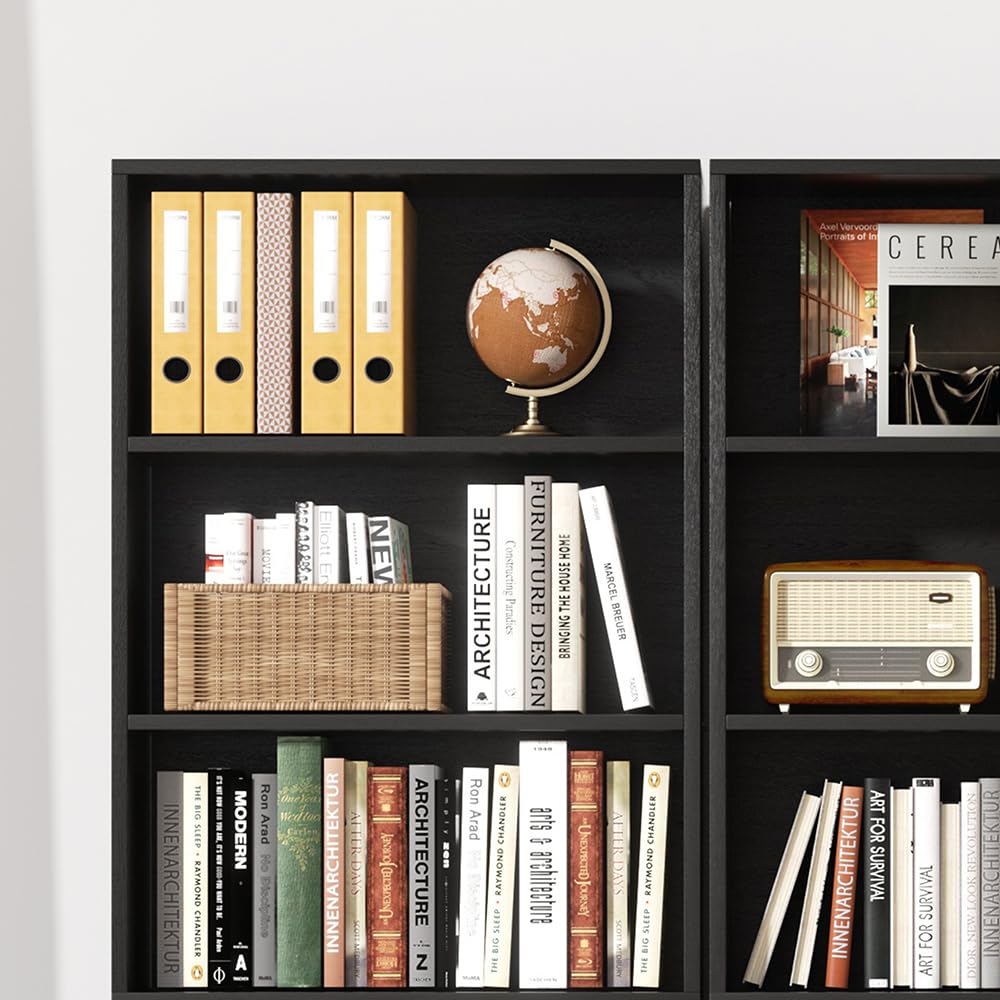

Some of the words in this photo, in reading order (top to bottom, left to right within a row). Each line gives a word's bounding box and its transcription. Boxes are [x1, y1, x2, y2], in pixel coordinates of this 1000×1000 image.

[531, 480, 546, 615] FURNITURE
[558, 534, 570, 559] HOME
[558, 562, 570, 592] HOUSE
[473, 507, 490, 680] ARCHITECTURE
[558, 595, 570, 612] THE
[603, 562, 618, 601] MARCEL
[611, 602, 627, 641] BREUER
[558, 615, 571, 659] BRINGING
[531, 623, 546, 708] DESIGN
[215, 775, 223, 786] IT'S
[215, 786, 223, 796] NOT
[469, 778, 483, 805] Ron
[215, 796, 223, 807] HOW
[869, 790, 885, 814] ART
[215, 821, 223, 832] YOU
[234, 790, 247, 870] MODERN
[468, 809, 482, 841] Arad
[529, 808, 556, 831] arts
[869, 818, 885, 844] FOR
[215, 854, 223, 865] HOW
[414, 777, 429, 926] ARCHITECTURE
[194, 860, 202, 907] RAYMOND
[215, 879, 223, 889] YOU
[529, 851, 559, 924] architecture
[869, 846, 885, 903] SURVIVAL
[163, 803, 180, 974] INNENARCHITEKTUR
[215, 890, 223, 904] WANT
[194, 910, 202, 958] CHANDLER
[215, 927, 223, 938] Paul
[215, 939, 223, 953] Arden
[234, 954, 247, 972] A
